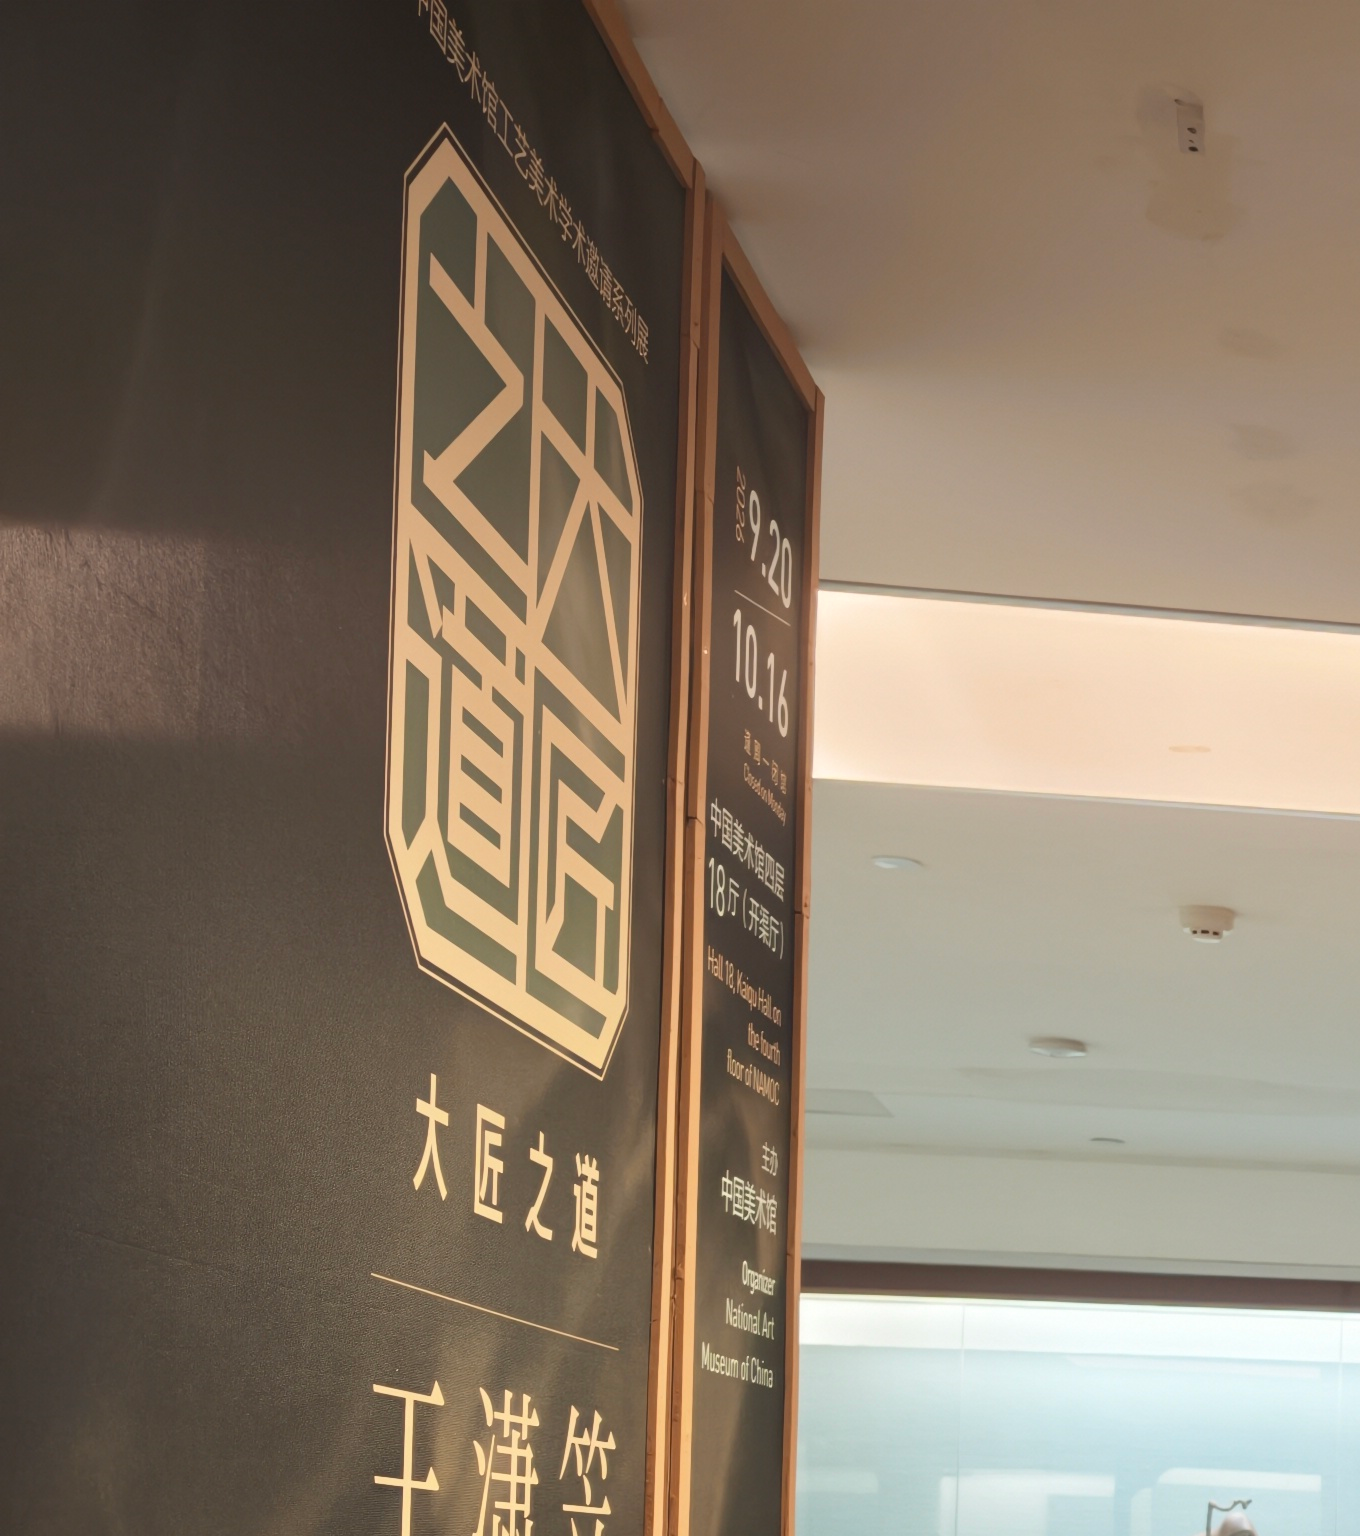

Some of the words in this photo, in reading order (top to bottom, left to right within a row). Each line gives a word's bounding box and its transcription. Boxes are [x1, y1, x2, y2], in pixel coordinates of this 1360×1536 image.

[749, 490, 793, 609] 9.20
[733, 608, 789, 738] 10.16
[710, 798, 785, 903] 中国美术馆四层
[707, 945, 724, 982] Hall
[758, 987, 773, 1020] Hall
[772, 1004, 782, 1027] on
[748, 1022, 760, 1051] the
[760, 1031, 781, 1066] fourth
[727, 1048, 743, 1083] floor
[744, 1064, 753, 1088] of
[753, 1068, 780, 1106] NAMOC
[412, 1073, 601, 1259] 大匠之道
[761, 1141, 779, 1177] 主办
[721, 1169, 778, 1236] 中国美术馆
[742, 1260, 776, 1296] Organizer
[725, 1297, 761, 1337] National
[761, 1311, 775, 1341] Art
[701, 1341, 739, 1379] Museum
[740, 1355, 750, 1380] of
[750, 1356, 774, 1389] China
